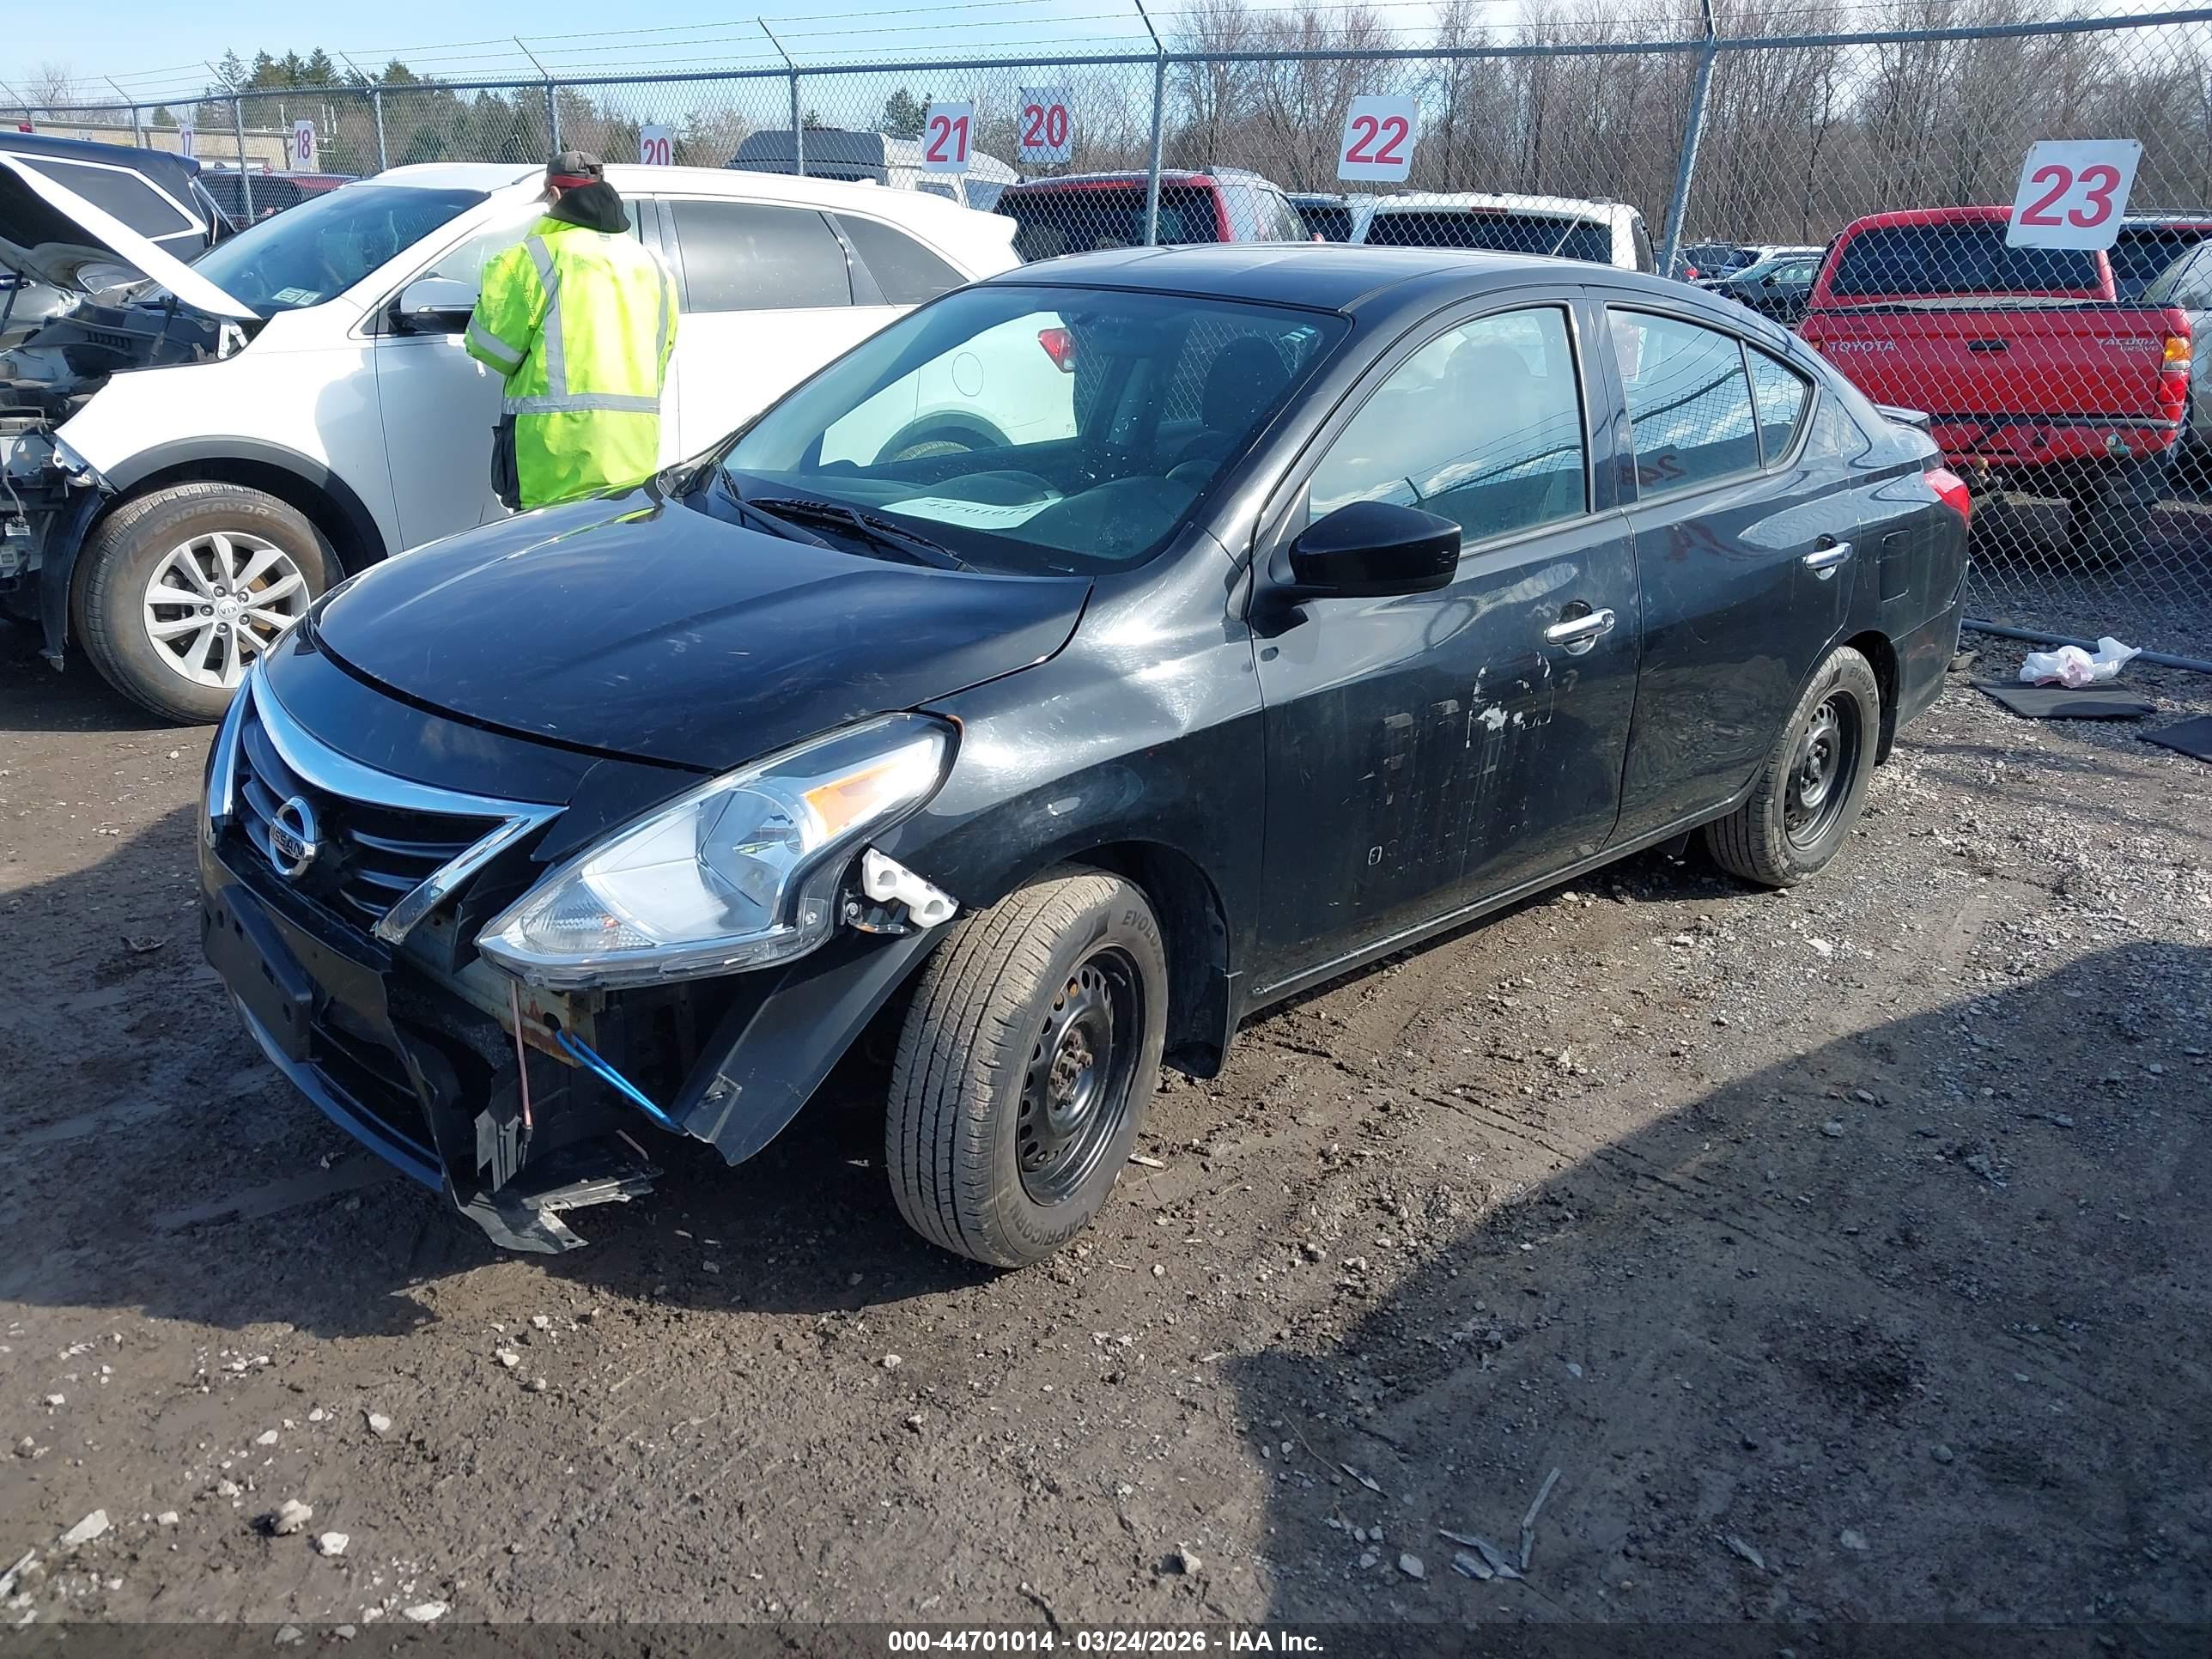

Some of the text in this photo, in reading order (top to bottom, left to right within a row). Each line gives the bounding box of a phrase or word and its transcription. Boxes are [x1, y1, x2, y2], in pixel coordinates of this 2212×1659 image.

[181, 131, 192, 156] 17
[295, 129, 311, 160] 18
[926, 115, 969, 162] 21
[1023, 104, 1067, 148] 20
[1345, 115, 1409, 165] 22
[643, 137, 670, 166] 20
[2019, 164, 2122, 228] 23
[1829, 341, 1895, 352] TOYOTA
